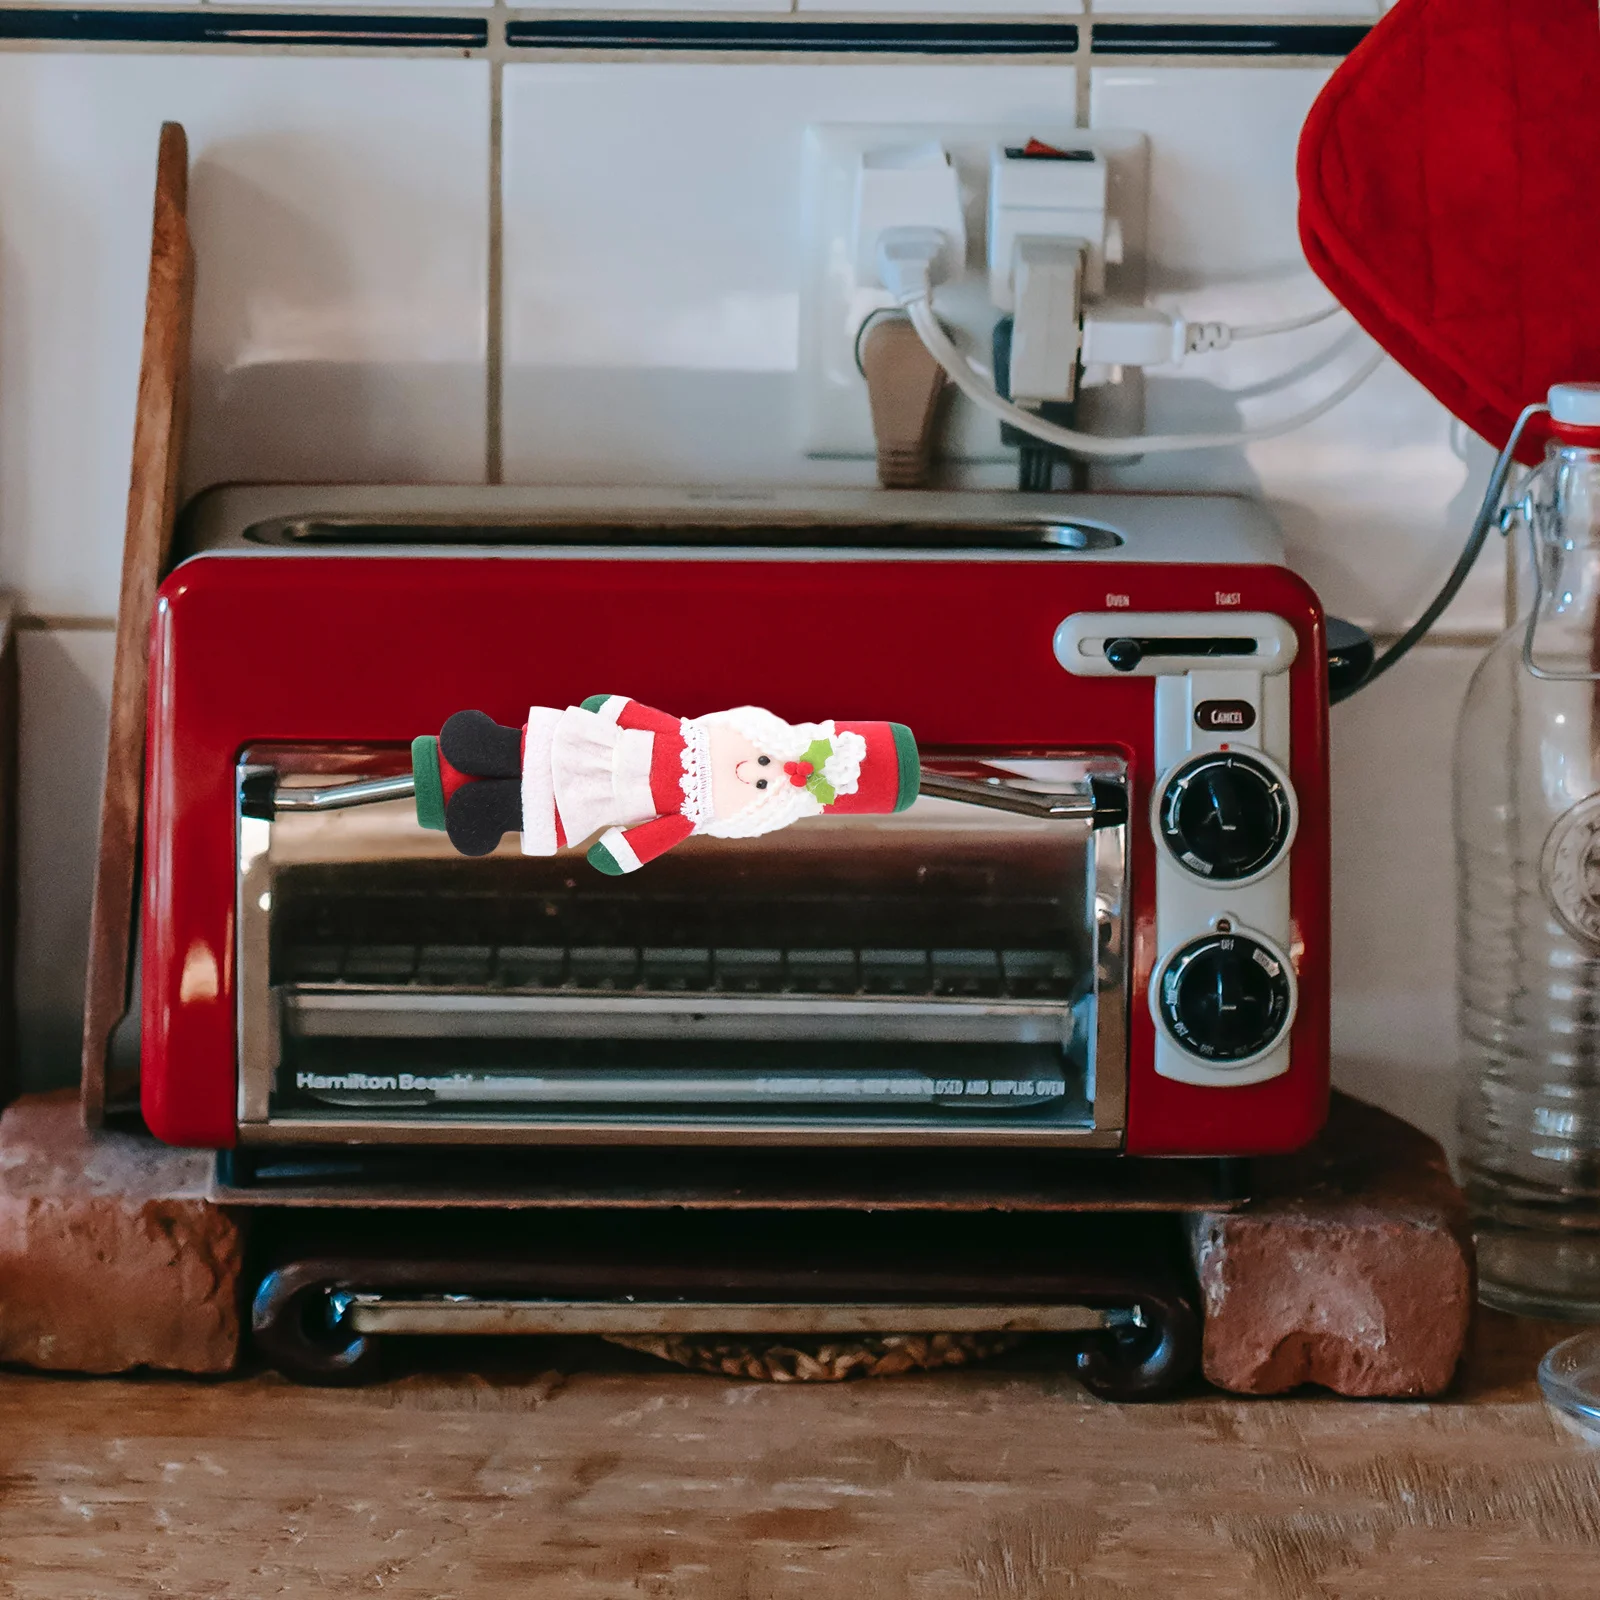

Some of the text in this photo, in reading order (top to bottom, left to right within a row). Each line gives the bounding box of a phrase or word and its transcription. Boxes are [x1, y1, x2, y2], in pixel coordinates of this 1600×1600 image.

[1106, 592, 1130, 607] OVEN
[1214, 591, 1241, 605] TOAST
[1211, 709, 1243, 724] CANCEL
[296, 1072, 397, 1089] Hamilton
[965, 1079, 989, 1095] AND
[990, 1080, 1035, 1096] UNPLUG
[1036, 1080, 1066, 1096] OVEN
